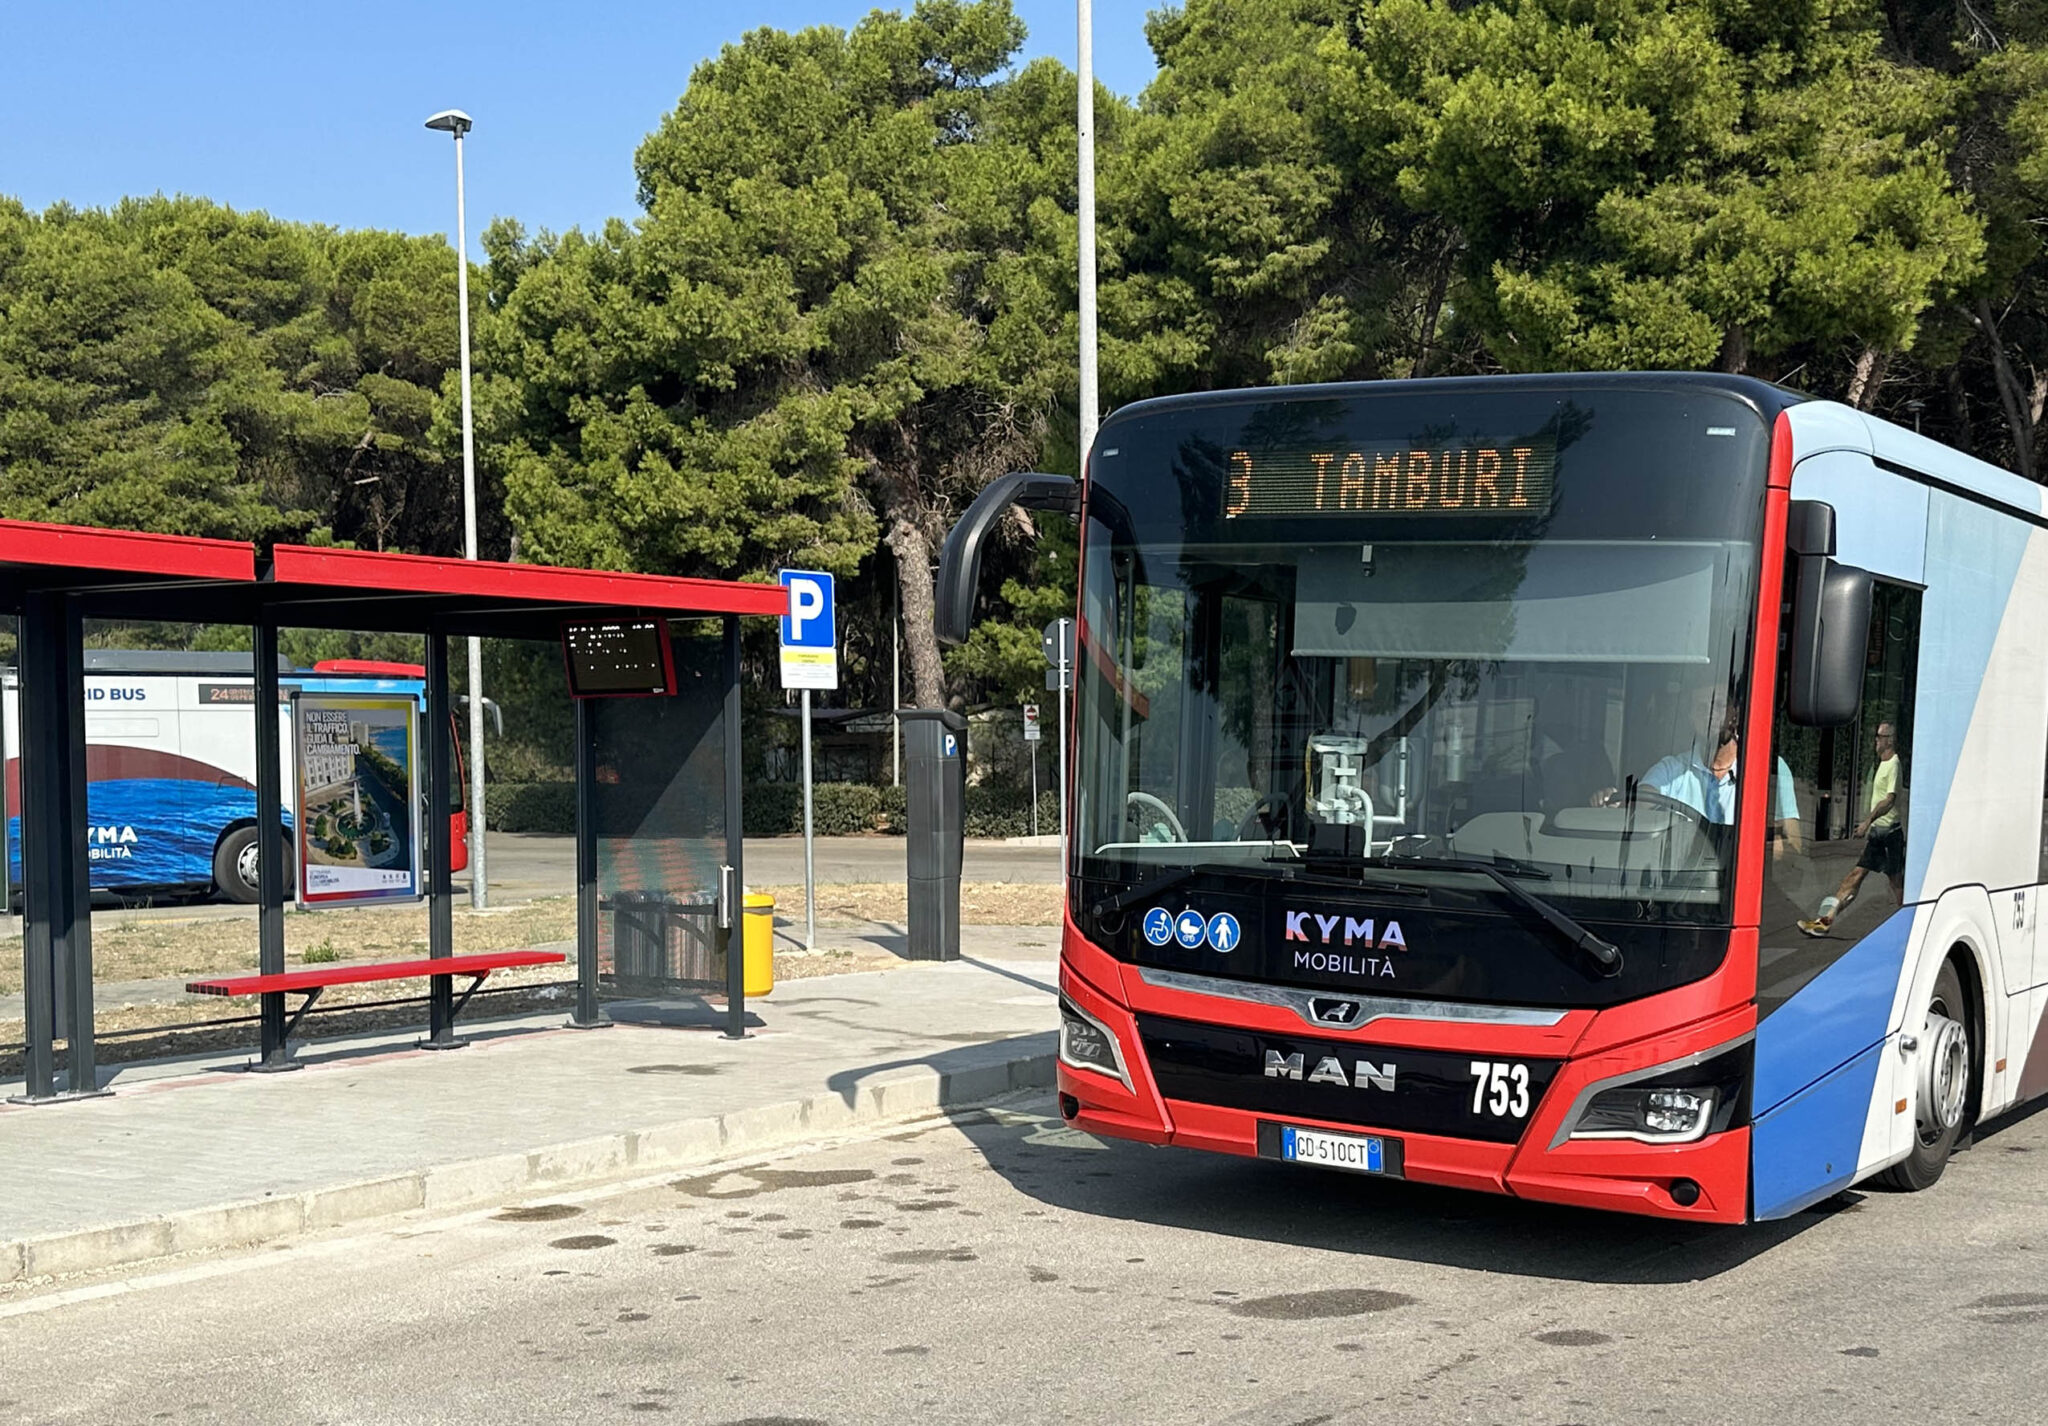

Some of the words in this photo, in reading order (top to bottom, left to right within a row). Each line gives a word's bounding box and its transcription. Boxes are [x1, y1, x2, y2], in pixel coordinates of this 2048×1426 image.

[1226, 451, 1252, 516] 3
[1311, 448, 1531, 509] TAMBURI
[790, 577, 824, 641] P
[83, 688, 105, 701] ID
[110, 688, 146, 701] BUS
[210, 688, 229, 701] 24
[306, 711, 322, 721] NON
[323, 711, 347, 722] ESSERE
[945, 734, 956, 756] P
[2012, 891, 2025, 930] 753
[1286, 911, 1408, 951] KYMA
[1294, 951, 1396, 978] MOBILITÀ
[1264, 1049, 1396, 1092] MAN
[1470, 1061, 1529, 1118] 753
